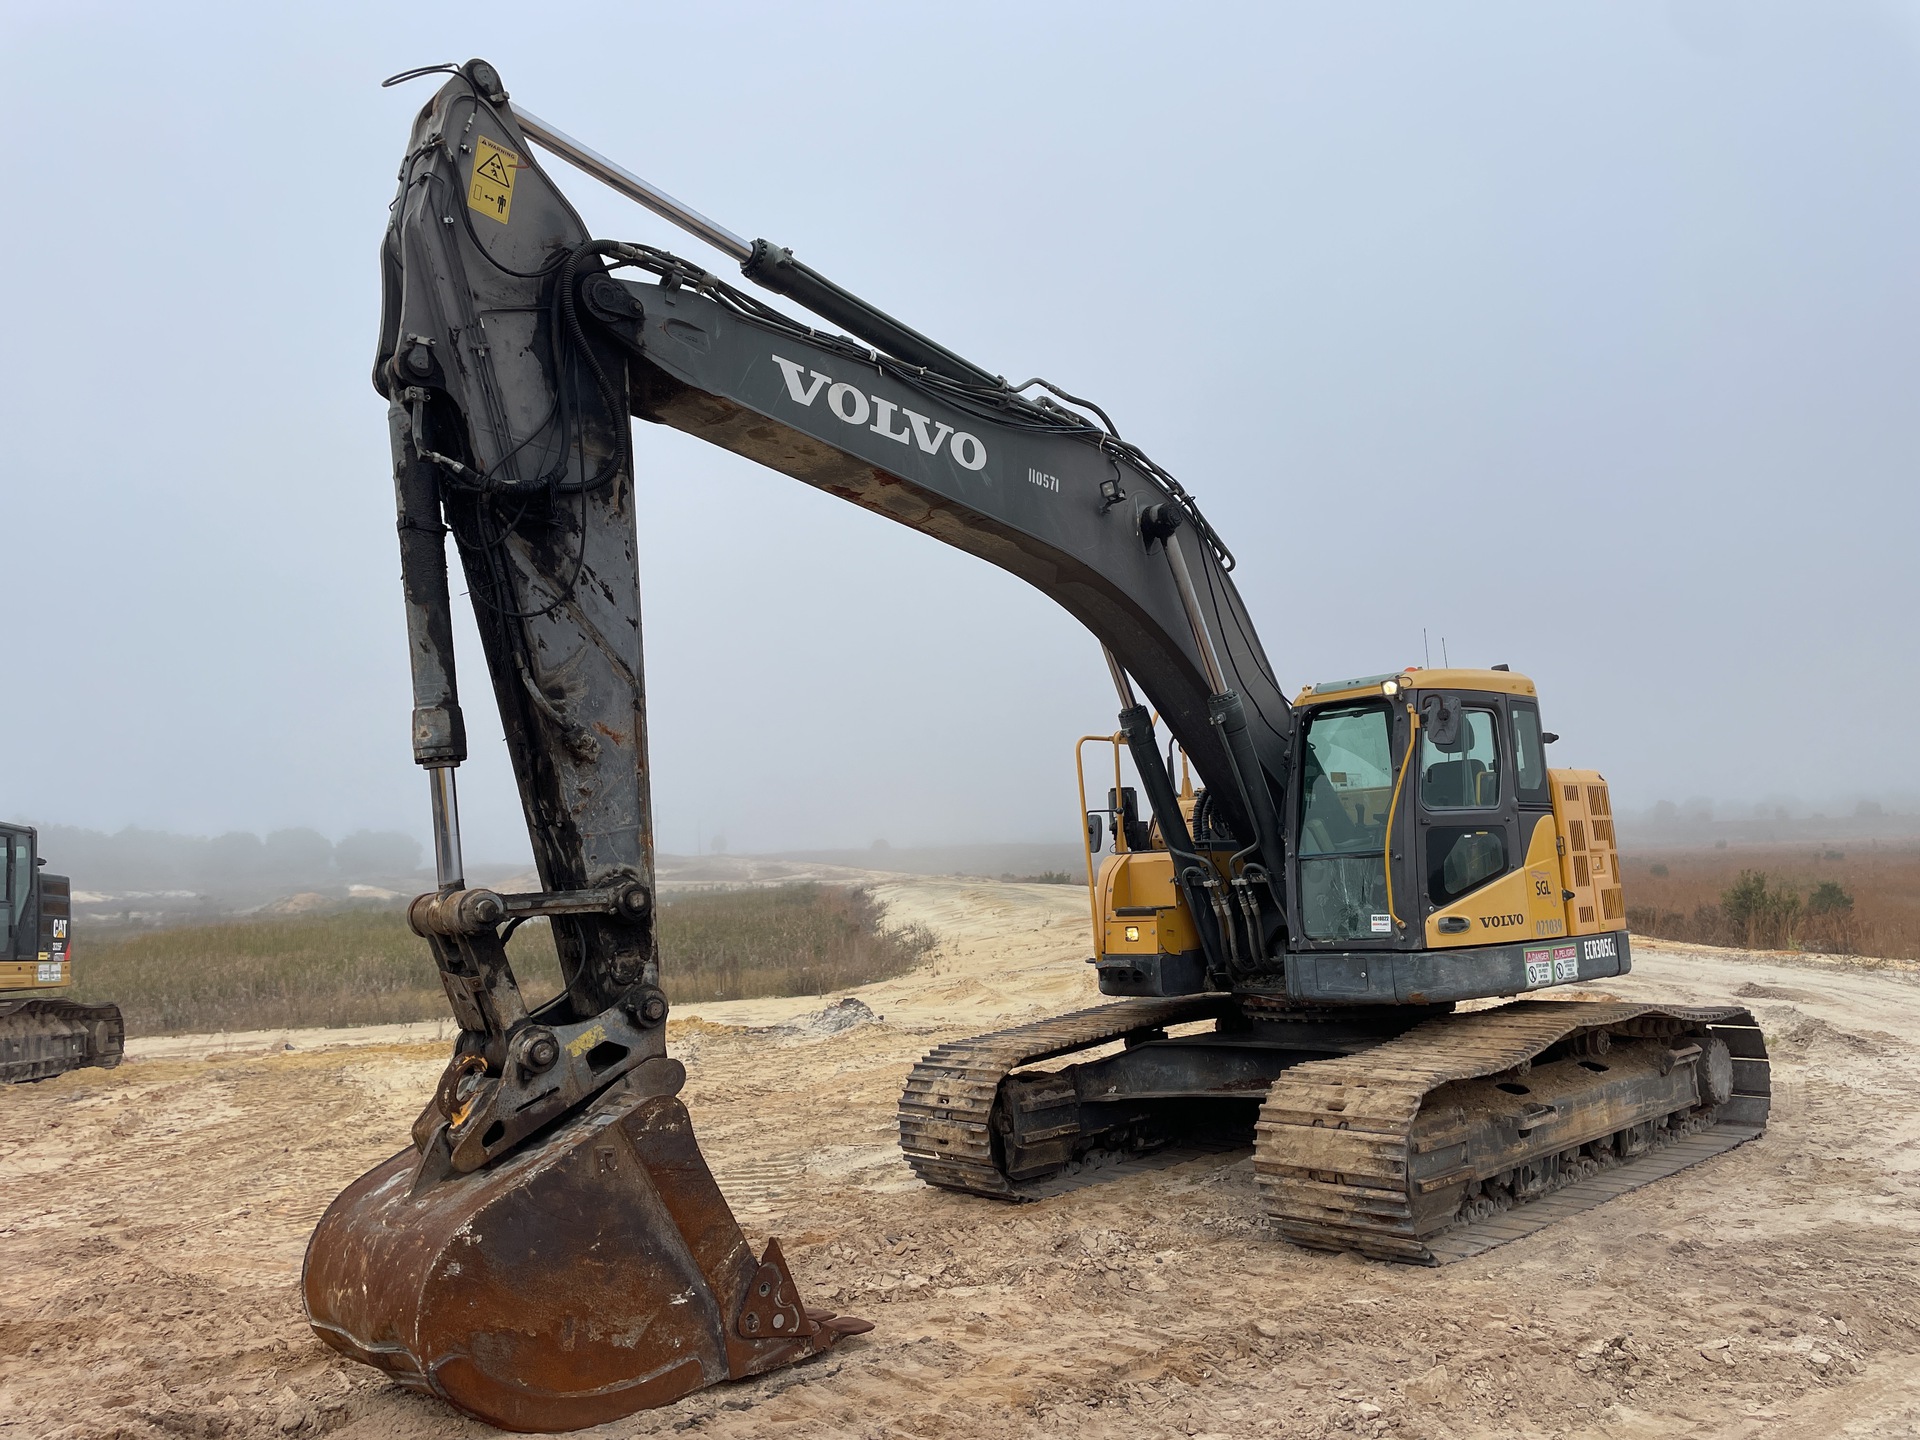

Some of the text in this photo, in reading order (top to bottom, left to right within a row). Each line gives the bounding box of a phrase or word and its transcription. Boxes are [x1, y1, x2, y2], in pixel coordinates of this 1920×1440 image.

[486, 142, 514, 159] WARNING
[771, 354, 987, 471] VOLVO
[1028, 467, 1059, 493] 110571
[1535, 880, 1551, 896] SGL
[53, 918, 67, 938] CAT
[1479, 913, 1524, 928] VOLVO
[1536, 919, 1562, 935] 021039
[1531, 951, 1549, 962] DANGER
[1559, 948, 1576, 959] PELIGRO
